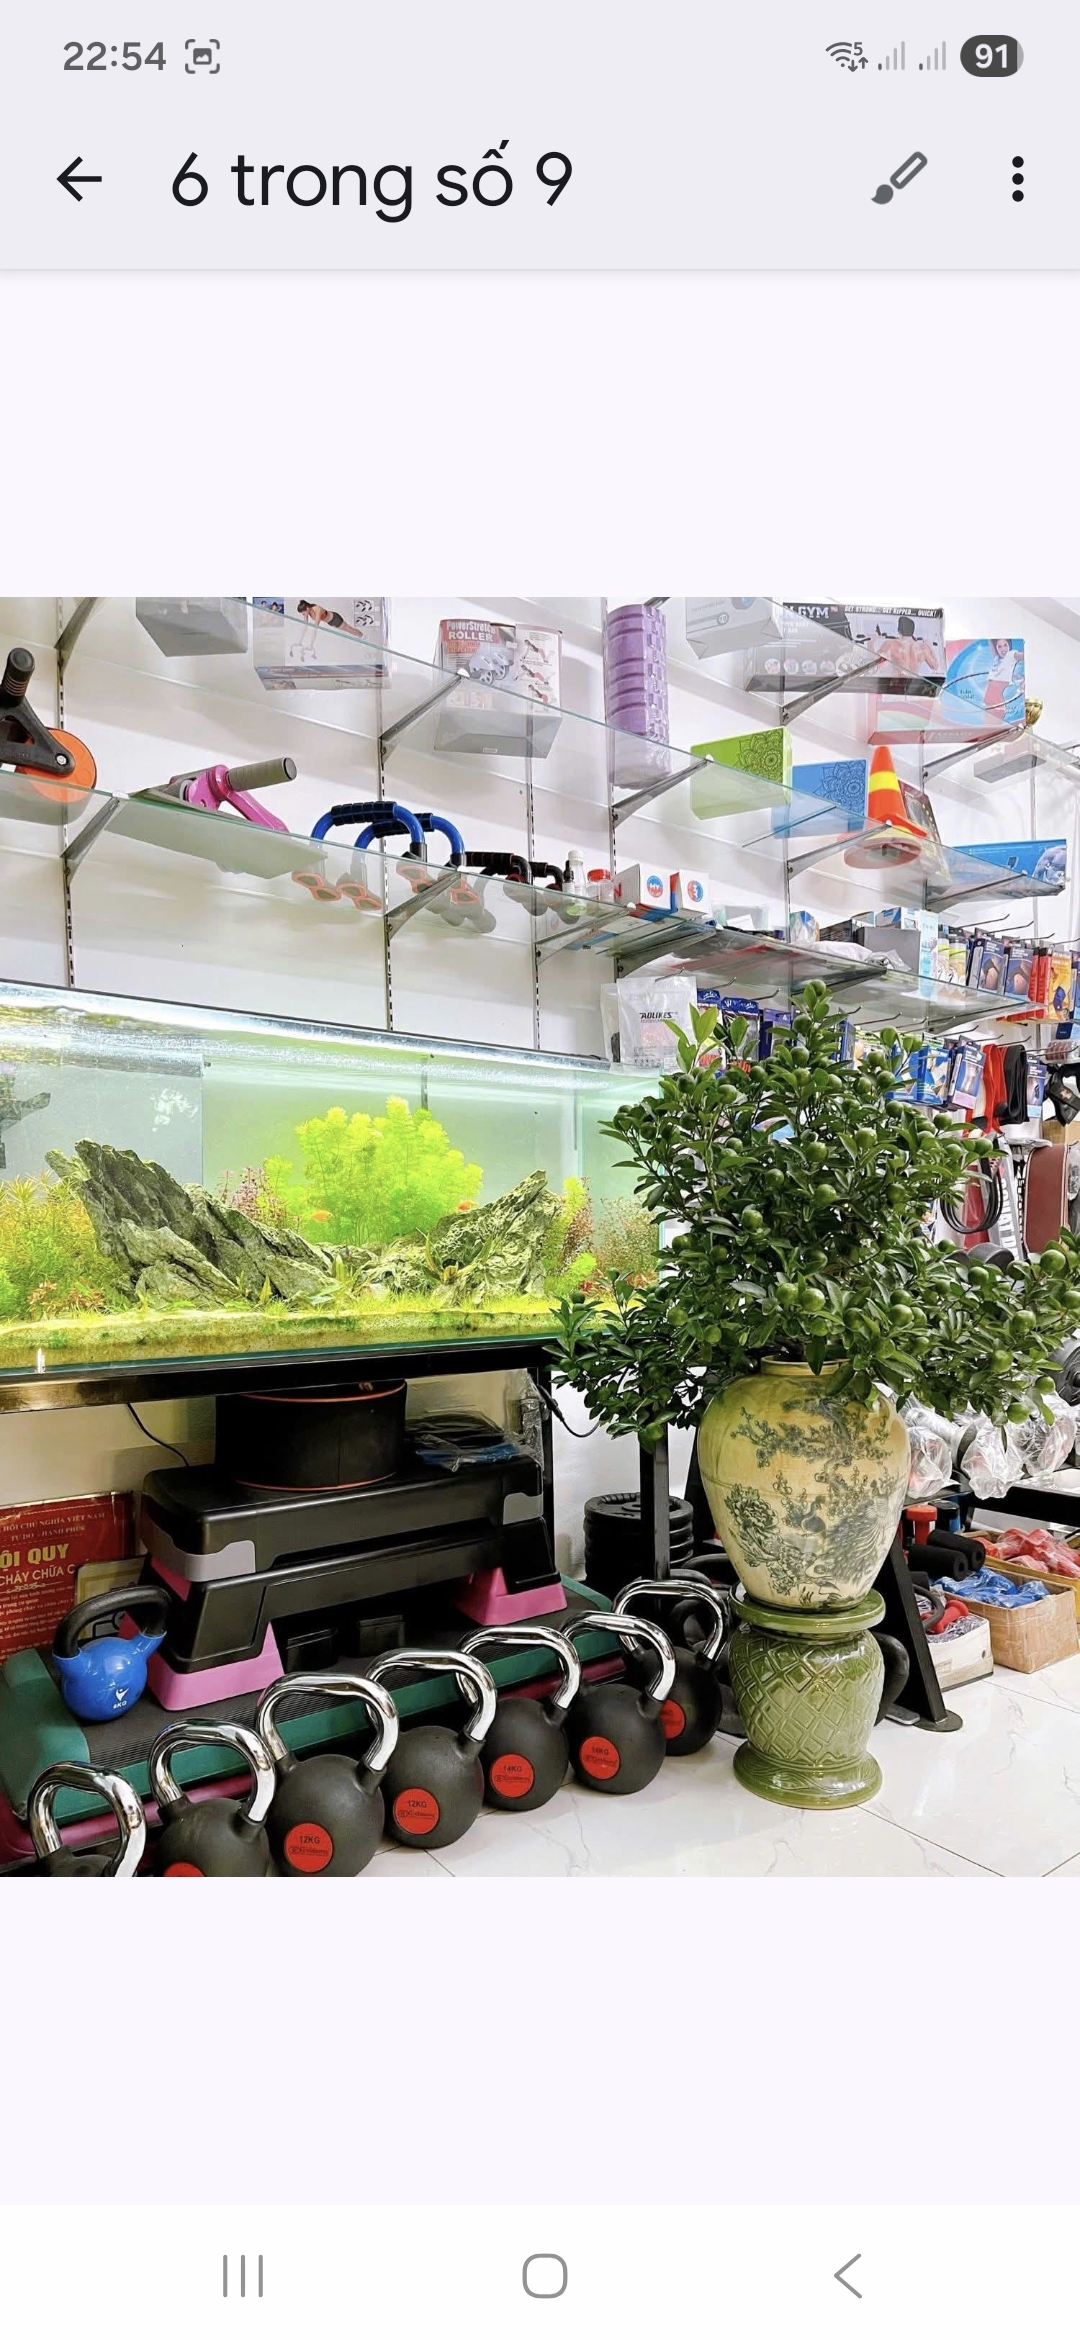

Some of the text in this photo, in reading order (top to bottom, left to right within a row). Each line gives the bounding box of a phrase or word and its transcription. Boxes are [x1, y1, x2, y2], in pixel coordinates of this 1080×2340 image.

[798, 605, 830, 619] GYM
[448, 630, 493, 642] ROLLER
[0, 1543, 69, 1572] ỘI QUY
[0, 1569, 29, 1587] CHÁY
[32, 1564, 65, 1581] CHỮA
[408, 1800, 427, 1808] 12KG
[299, 1835, 320, 1844] 12KG
